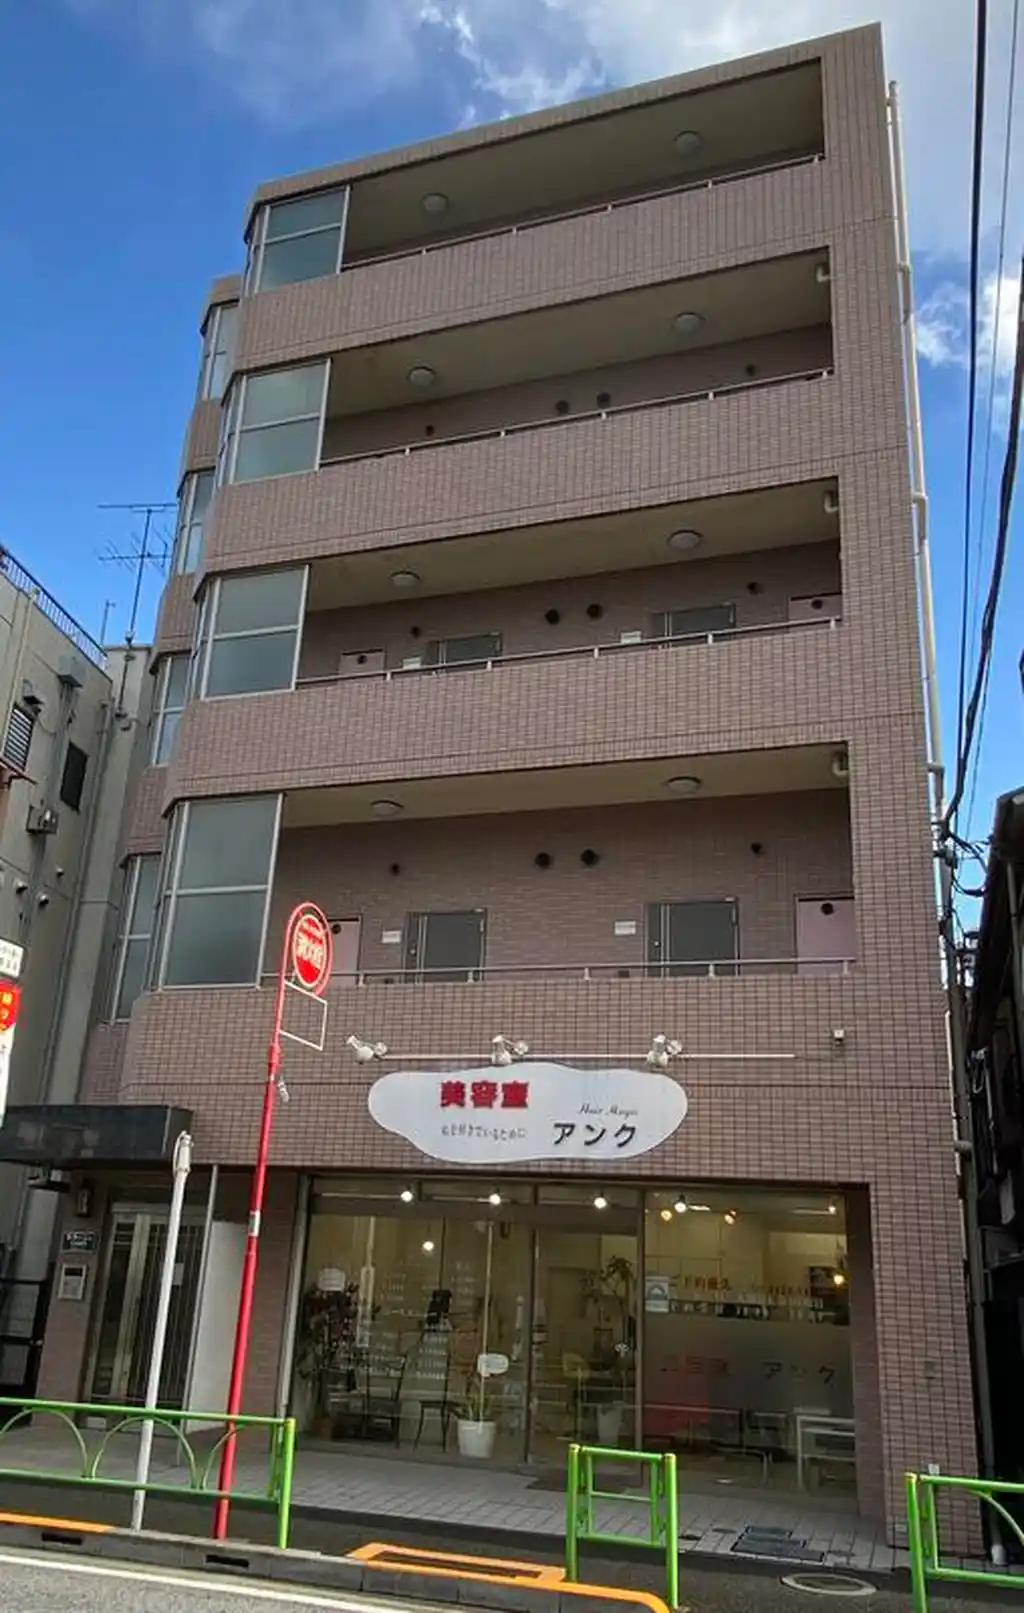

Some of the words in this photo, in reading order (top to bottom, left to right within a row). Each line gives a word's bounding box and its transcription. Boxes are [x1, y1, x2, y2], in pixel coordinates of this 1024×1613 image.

[440, 1080, 529, 1109] 美容室
[553, 1122, 636, 1149] アンク
